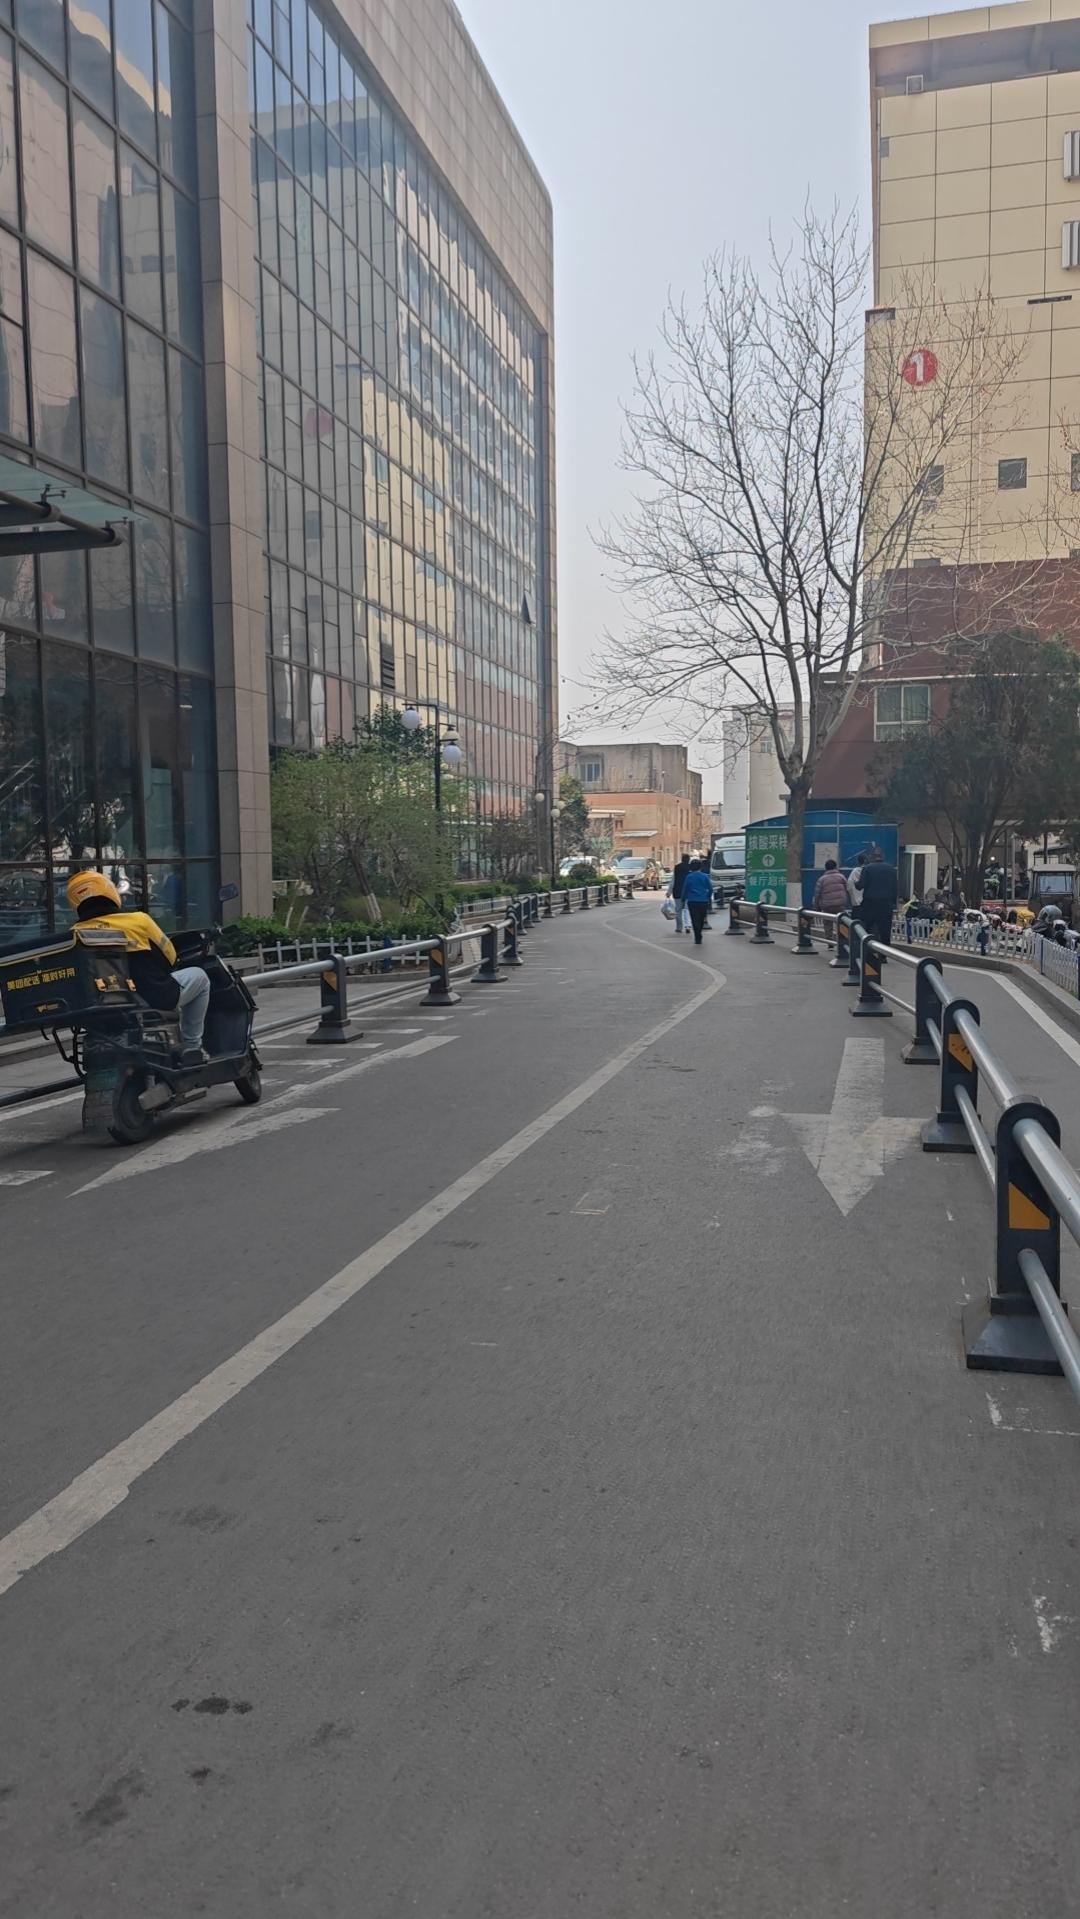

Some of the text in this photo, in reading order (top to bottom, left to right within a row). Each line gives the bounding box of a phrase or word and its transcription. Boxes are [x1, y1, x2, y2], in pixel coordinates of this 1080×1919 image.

[912, 352, 924, 382] 1
[748, 834, 788, 850] 核酸采样
[749, 876, 787, 887] 餐厅超市
